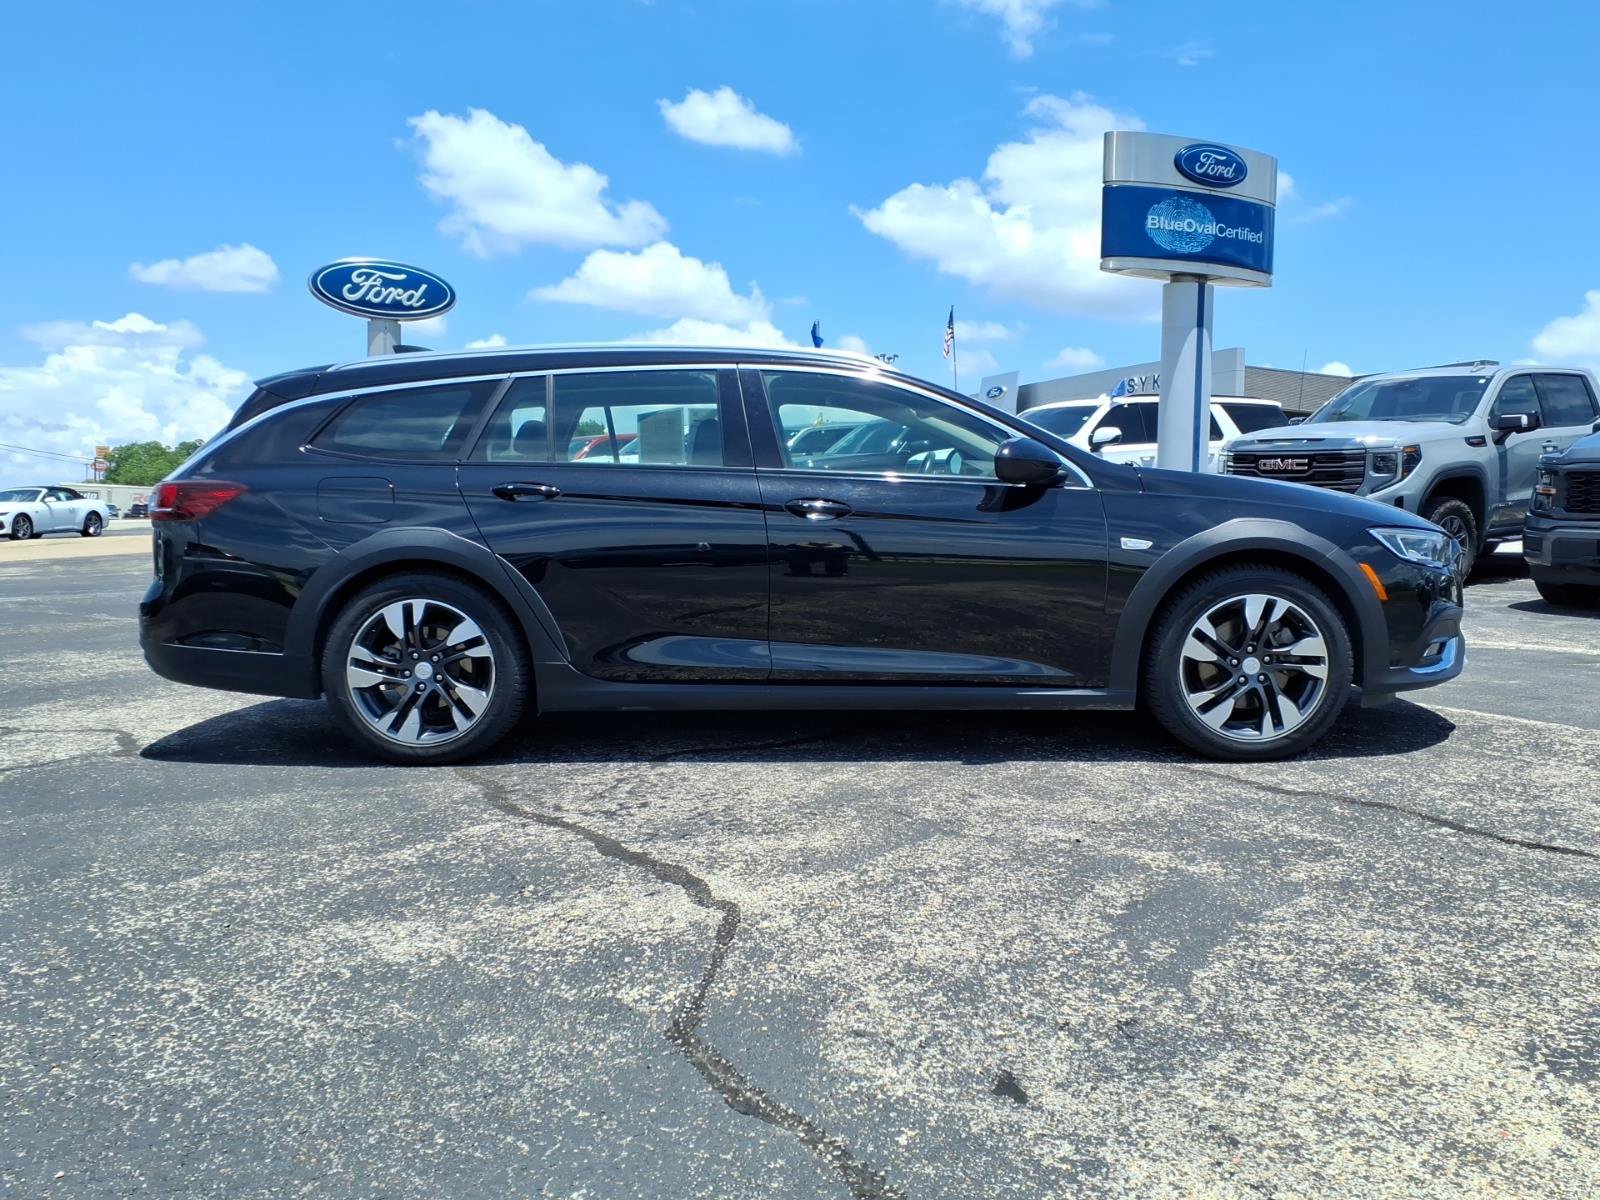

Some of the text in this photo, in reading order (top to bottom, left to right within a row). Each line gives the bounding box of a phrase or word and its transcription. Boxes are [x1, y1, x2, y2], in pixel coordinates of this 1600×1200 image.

[1195, 152, 1237, 179] Ford
[1147, 215, 1263, 243] BlueOvalCertified
[342, 268, 428, 307] Ford
[1258, 458, 1308, 470] GMC
